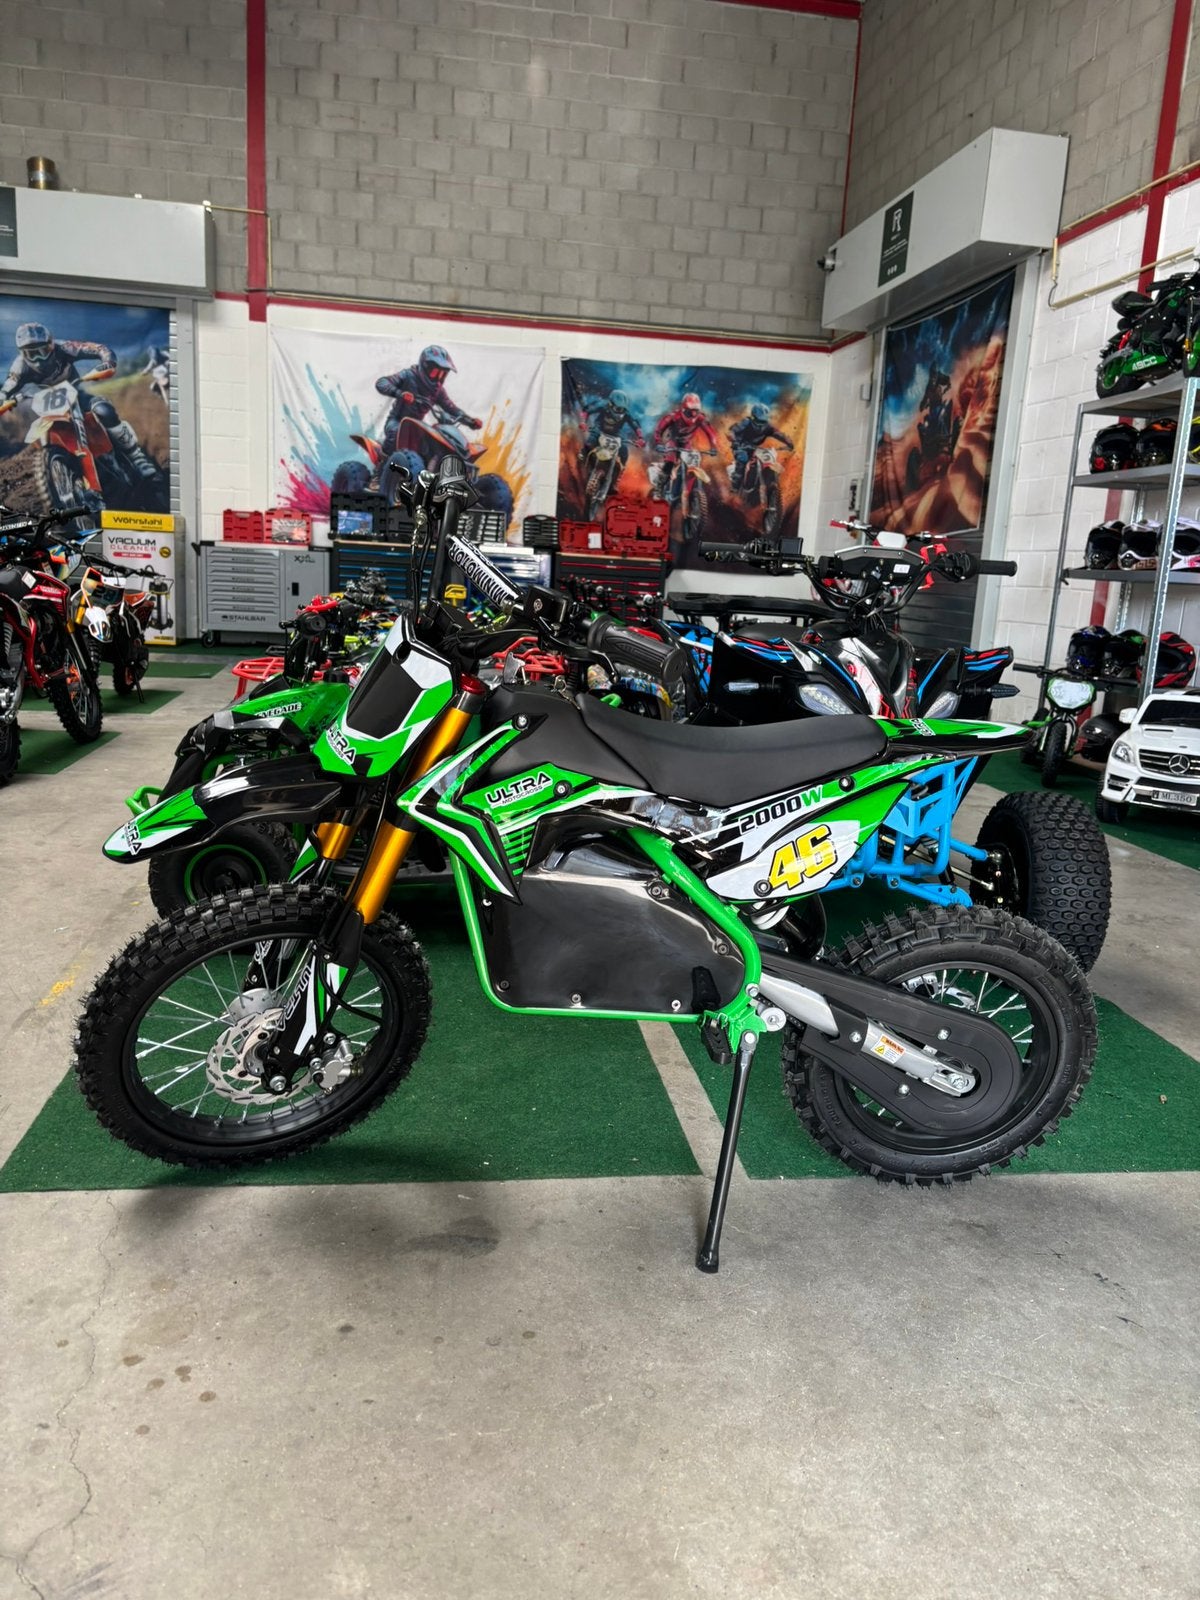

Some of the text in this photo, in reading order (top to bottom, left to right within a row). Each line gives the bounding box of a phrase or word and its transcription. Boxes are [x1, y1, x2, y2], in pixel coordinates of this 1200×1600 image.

[108, 537, 156, 545] VACUUM
[449, 542, 511, 605] MINIMOTOR
[486, 773, 551, 803] ULTRA
[502, 786, 543, 804] MOTOCROSS
[740, 785, 822, 834] 2000W
[768, 824, 838, 891] 46
